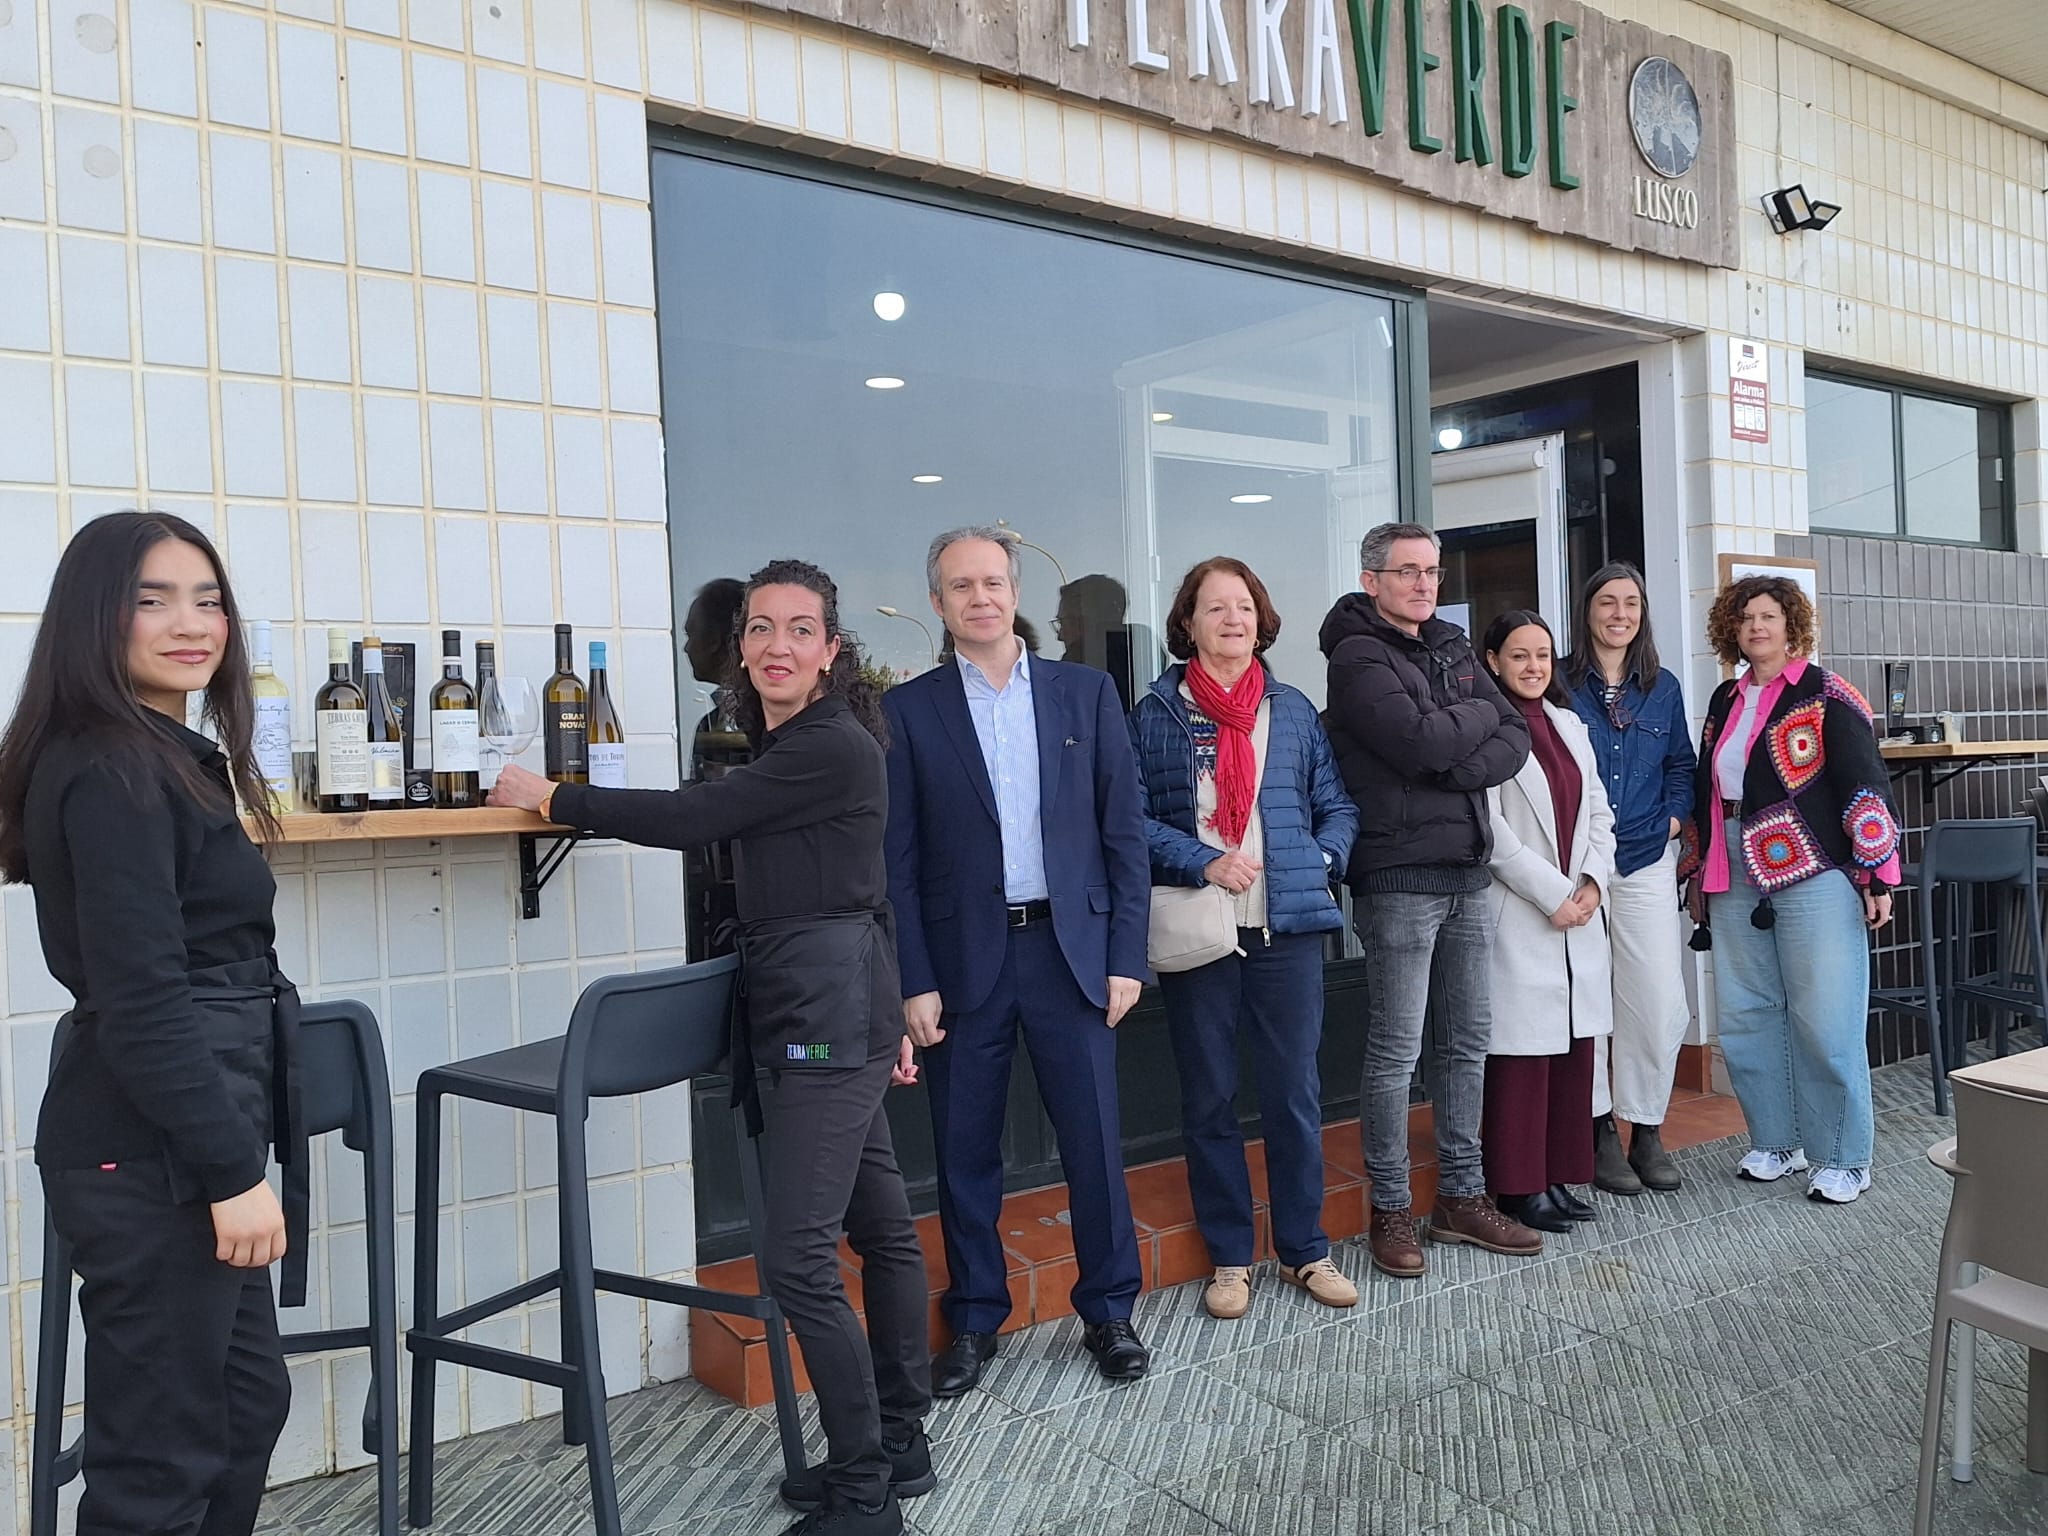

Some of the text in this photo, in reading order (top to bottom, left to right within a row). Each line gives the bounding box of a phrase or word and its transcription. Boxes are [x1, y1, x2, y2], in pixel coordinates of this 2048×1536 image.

[1066, 0, 1580, 191] RAVERDE
[1633, 176, 1698, 229] LUSCO
[1733, 380, 1765, 398] Alarma
[786, 1043, 831, 1060] TERRAVERDE
